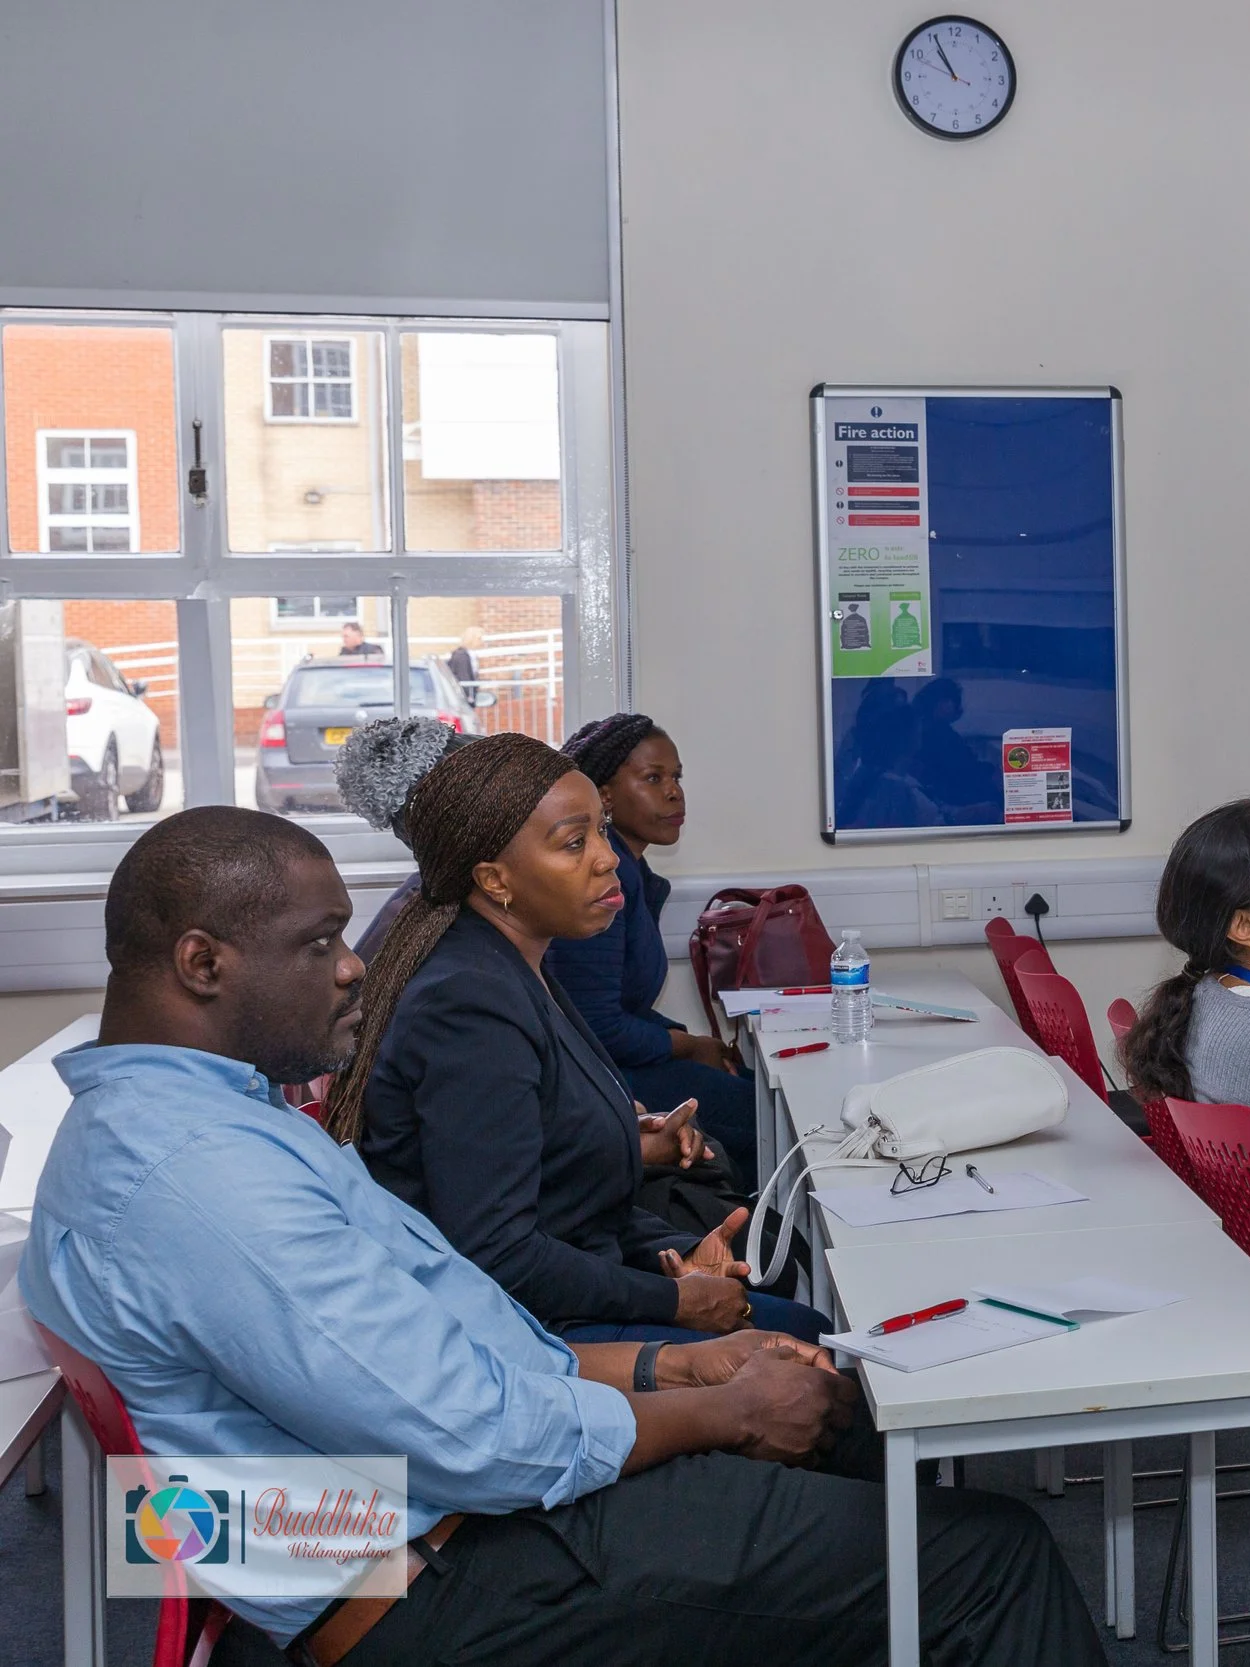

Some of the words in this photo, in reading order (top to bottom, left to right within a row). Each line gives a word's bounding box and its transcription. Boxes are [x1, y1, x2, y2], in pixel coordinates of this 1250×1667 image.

[948, 26, 962, 37] 12
[975, 33, 980, 44] 1
[910, 49, 924, 60] 10
[991, 51, 998, 62] 2
[904, 71, 912, 82] 9
[998, 75, 1005, 86] 3
[912, 95, 920, 106] 8
[991, 98, 999, 108] 4
[930, 112, 937, 123] 7
[975, 114, 982, 124] 5
[952, 119, 959, 130] 6
[838, 425, 867, 439] Fire
[870, 426, 915, 439] action
[838, 546, 880, 561] ZERO
